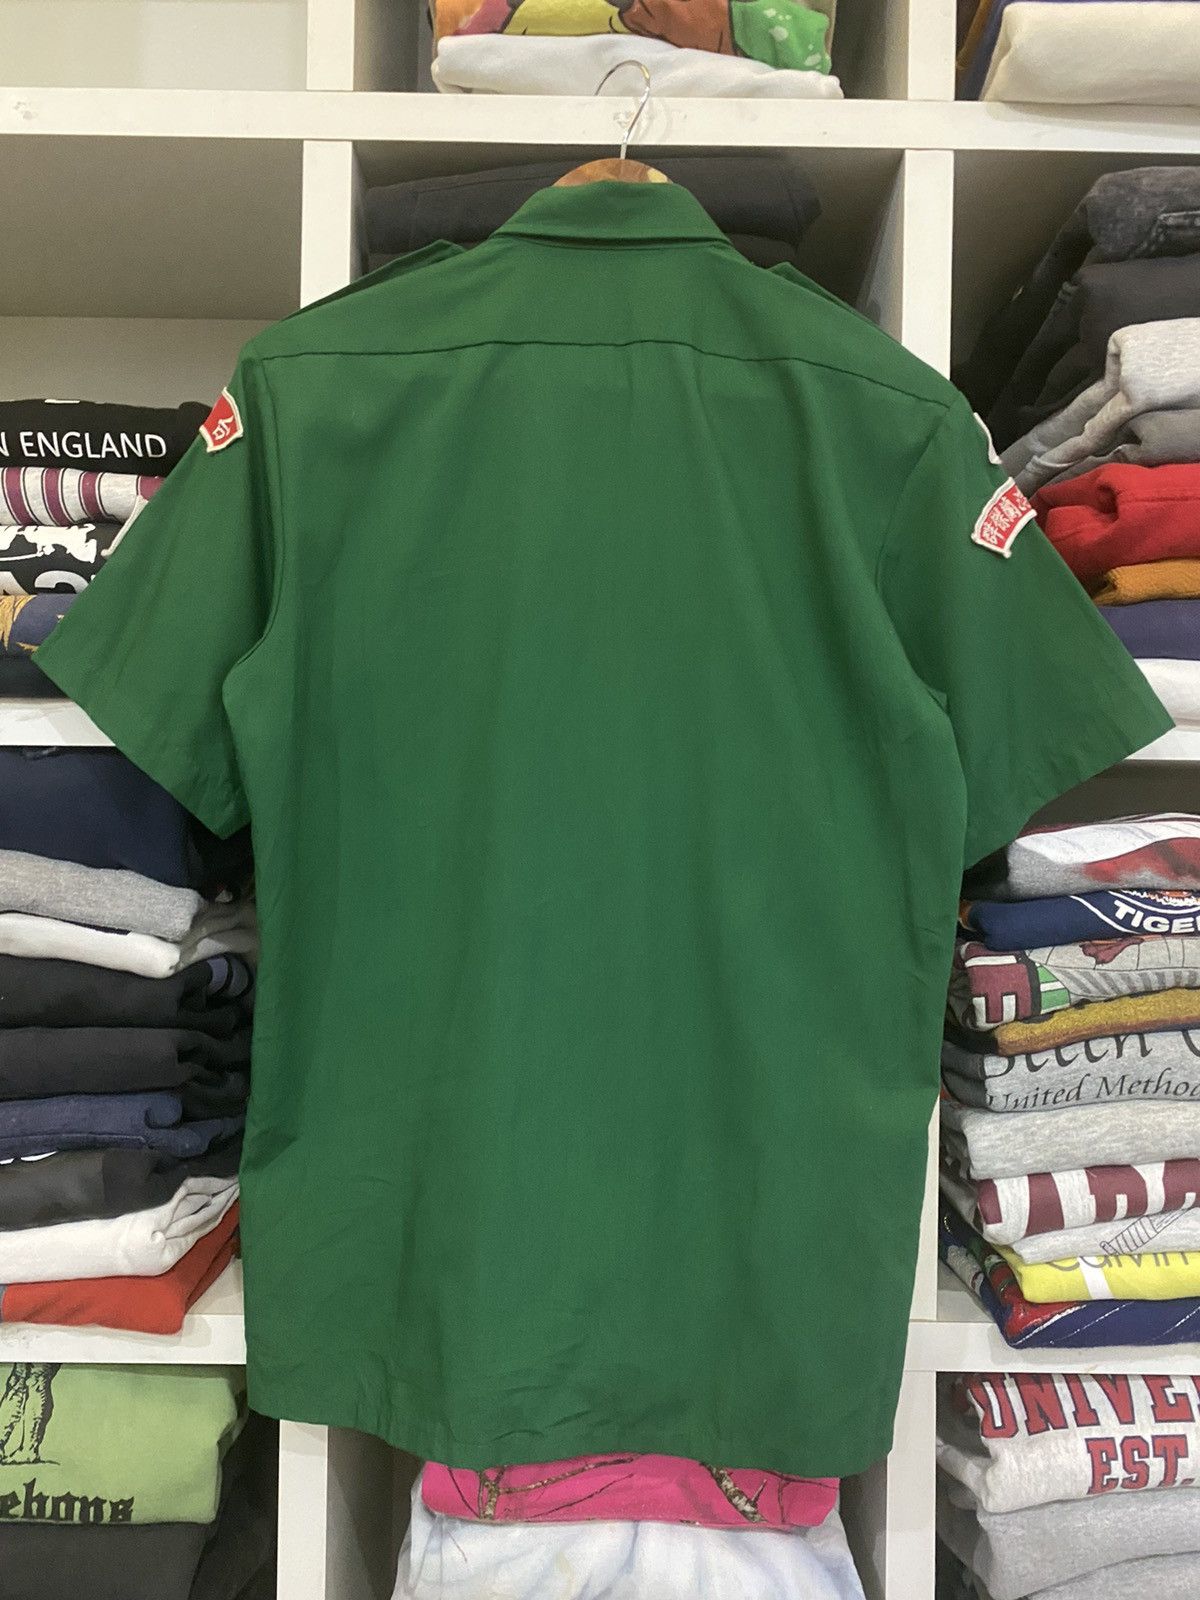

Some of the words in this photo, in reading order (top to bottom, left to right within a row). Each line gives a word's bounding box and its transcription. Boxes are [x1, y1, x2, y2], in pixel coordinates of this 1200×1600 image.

[19, 431, 167, 459] ENGLAND
[1113, 899, 1200, 934] TIGE
[962, 1373, 1200, 1438] UNIVE
